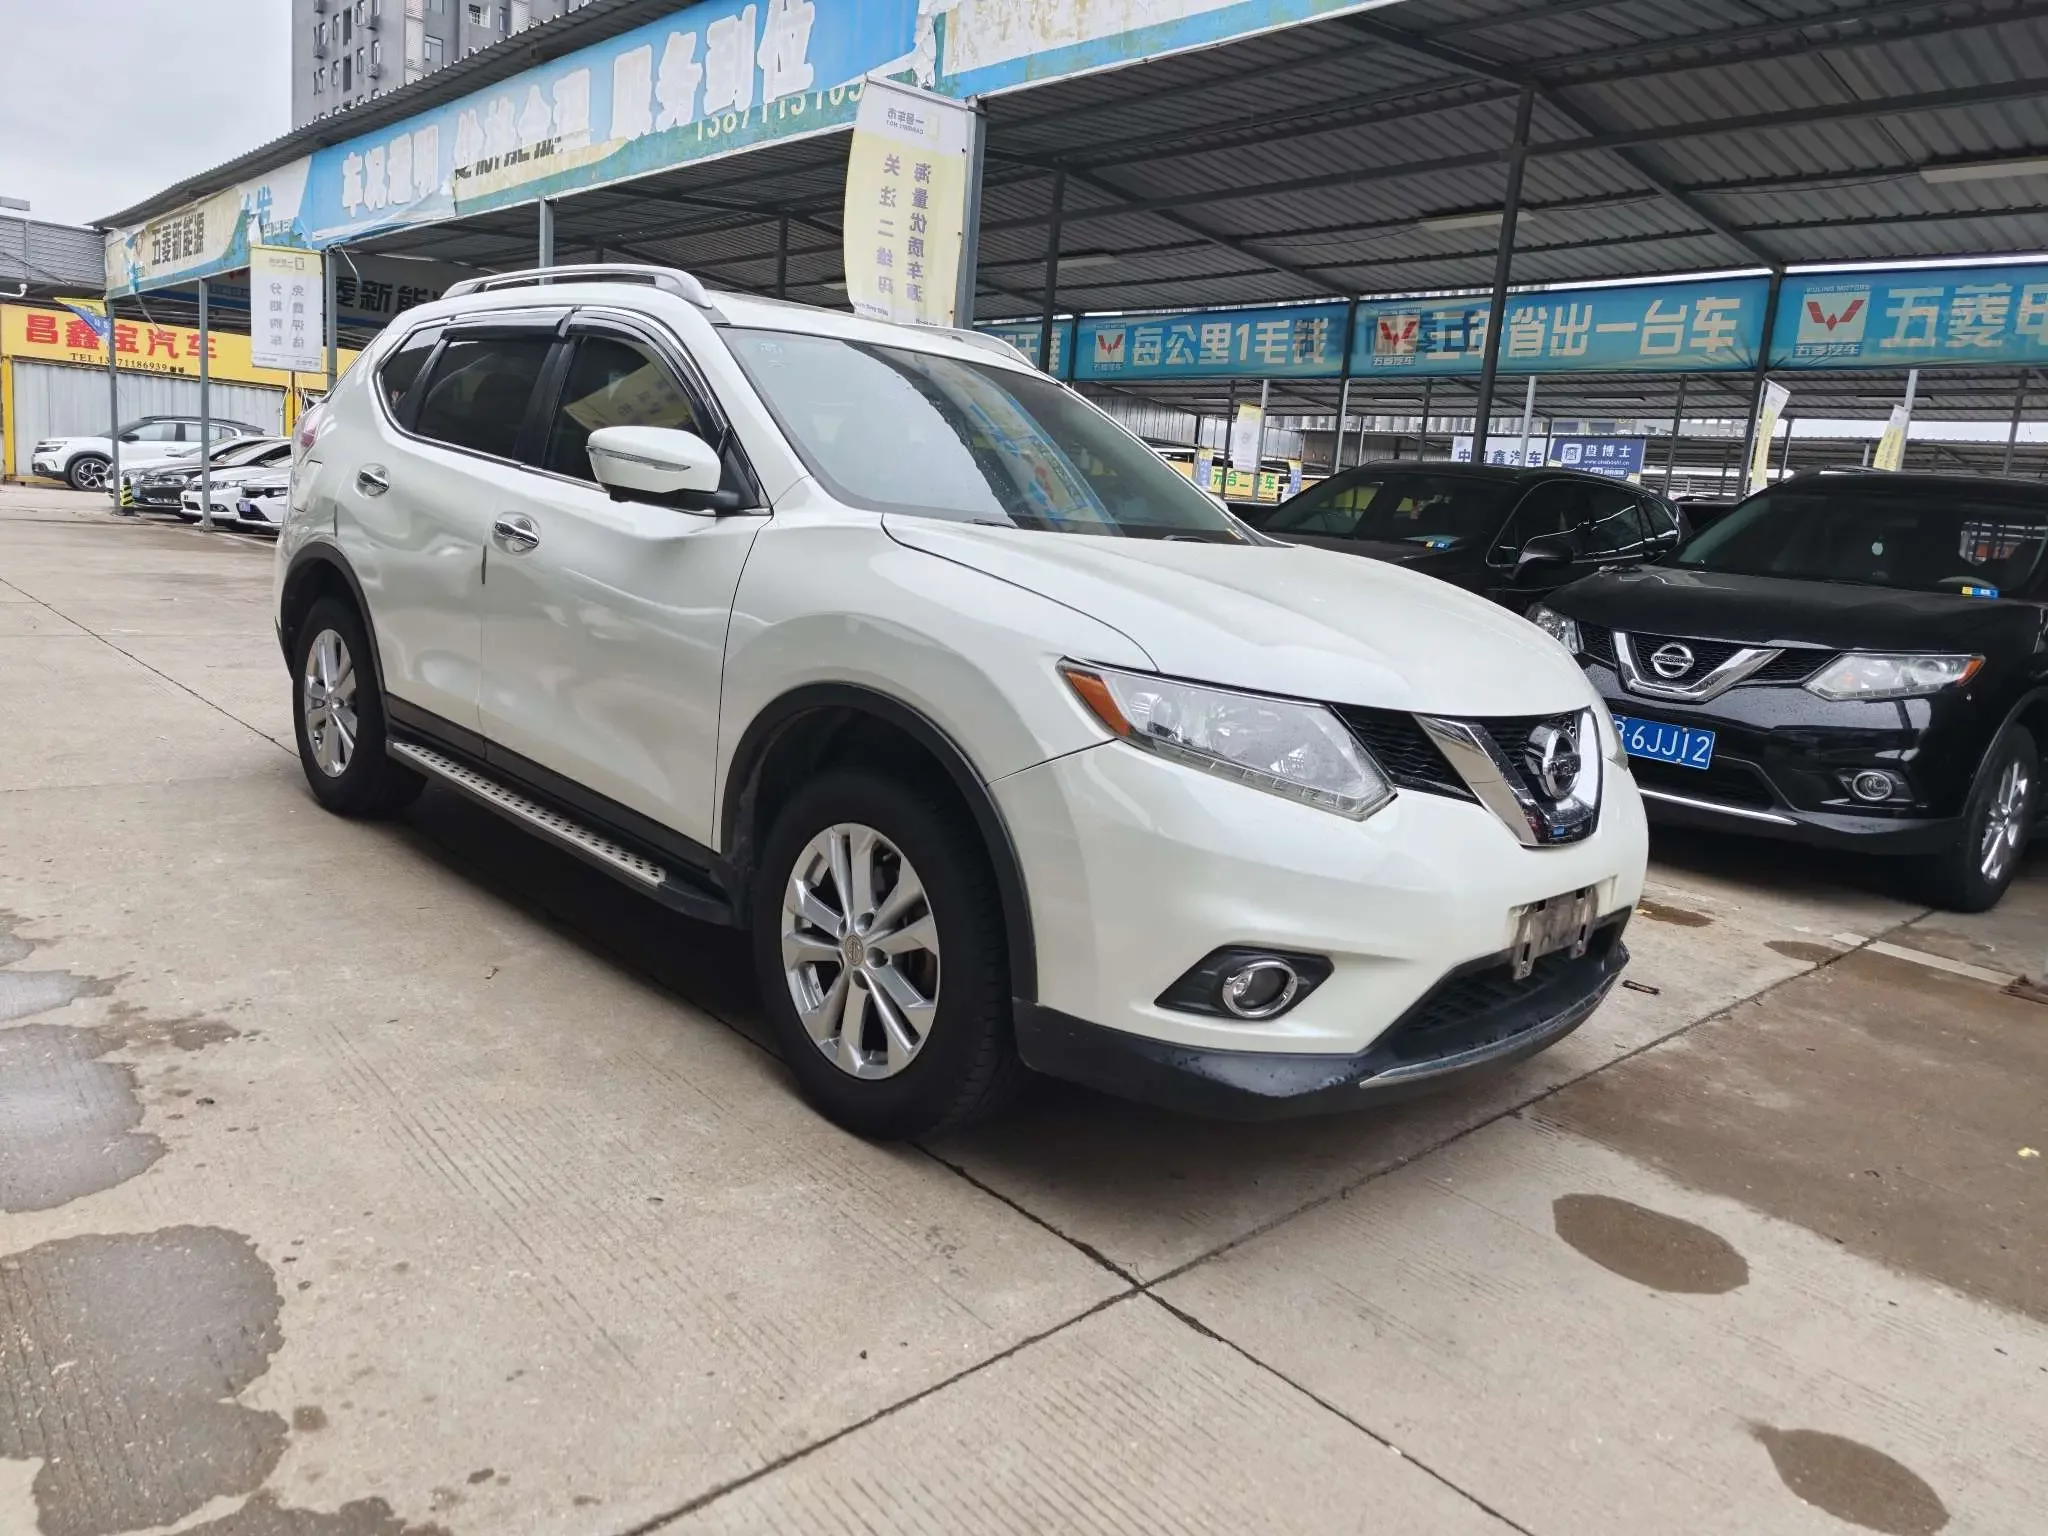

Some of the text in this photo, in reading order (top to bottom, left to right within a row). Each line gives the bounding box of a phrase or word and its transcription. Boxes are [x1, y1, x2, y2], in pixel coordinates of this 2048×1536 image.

[26, 314, 217, 359] 昌鑫宝汽车
[70, 352, 98, 363] TEL
[99, 355, 168, 371] 1371186939
[1458, 449, 1542, 466] 中鑫汽车
[1654, 654, 1691, 666] NISSAN
